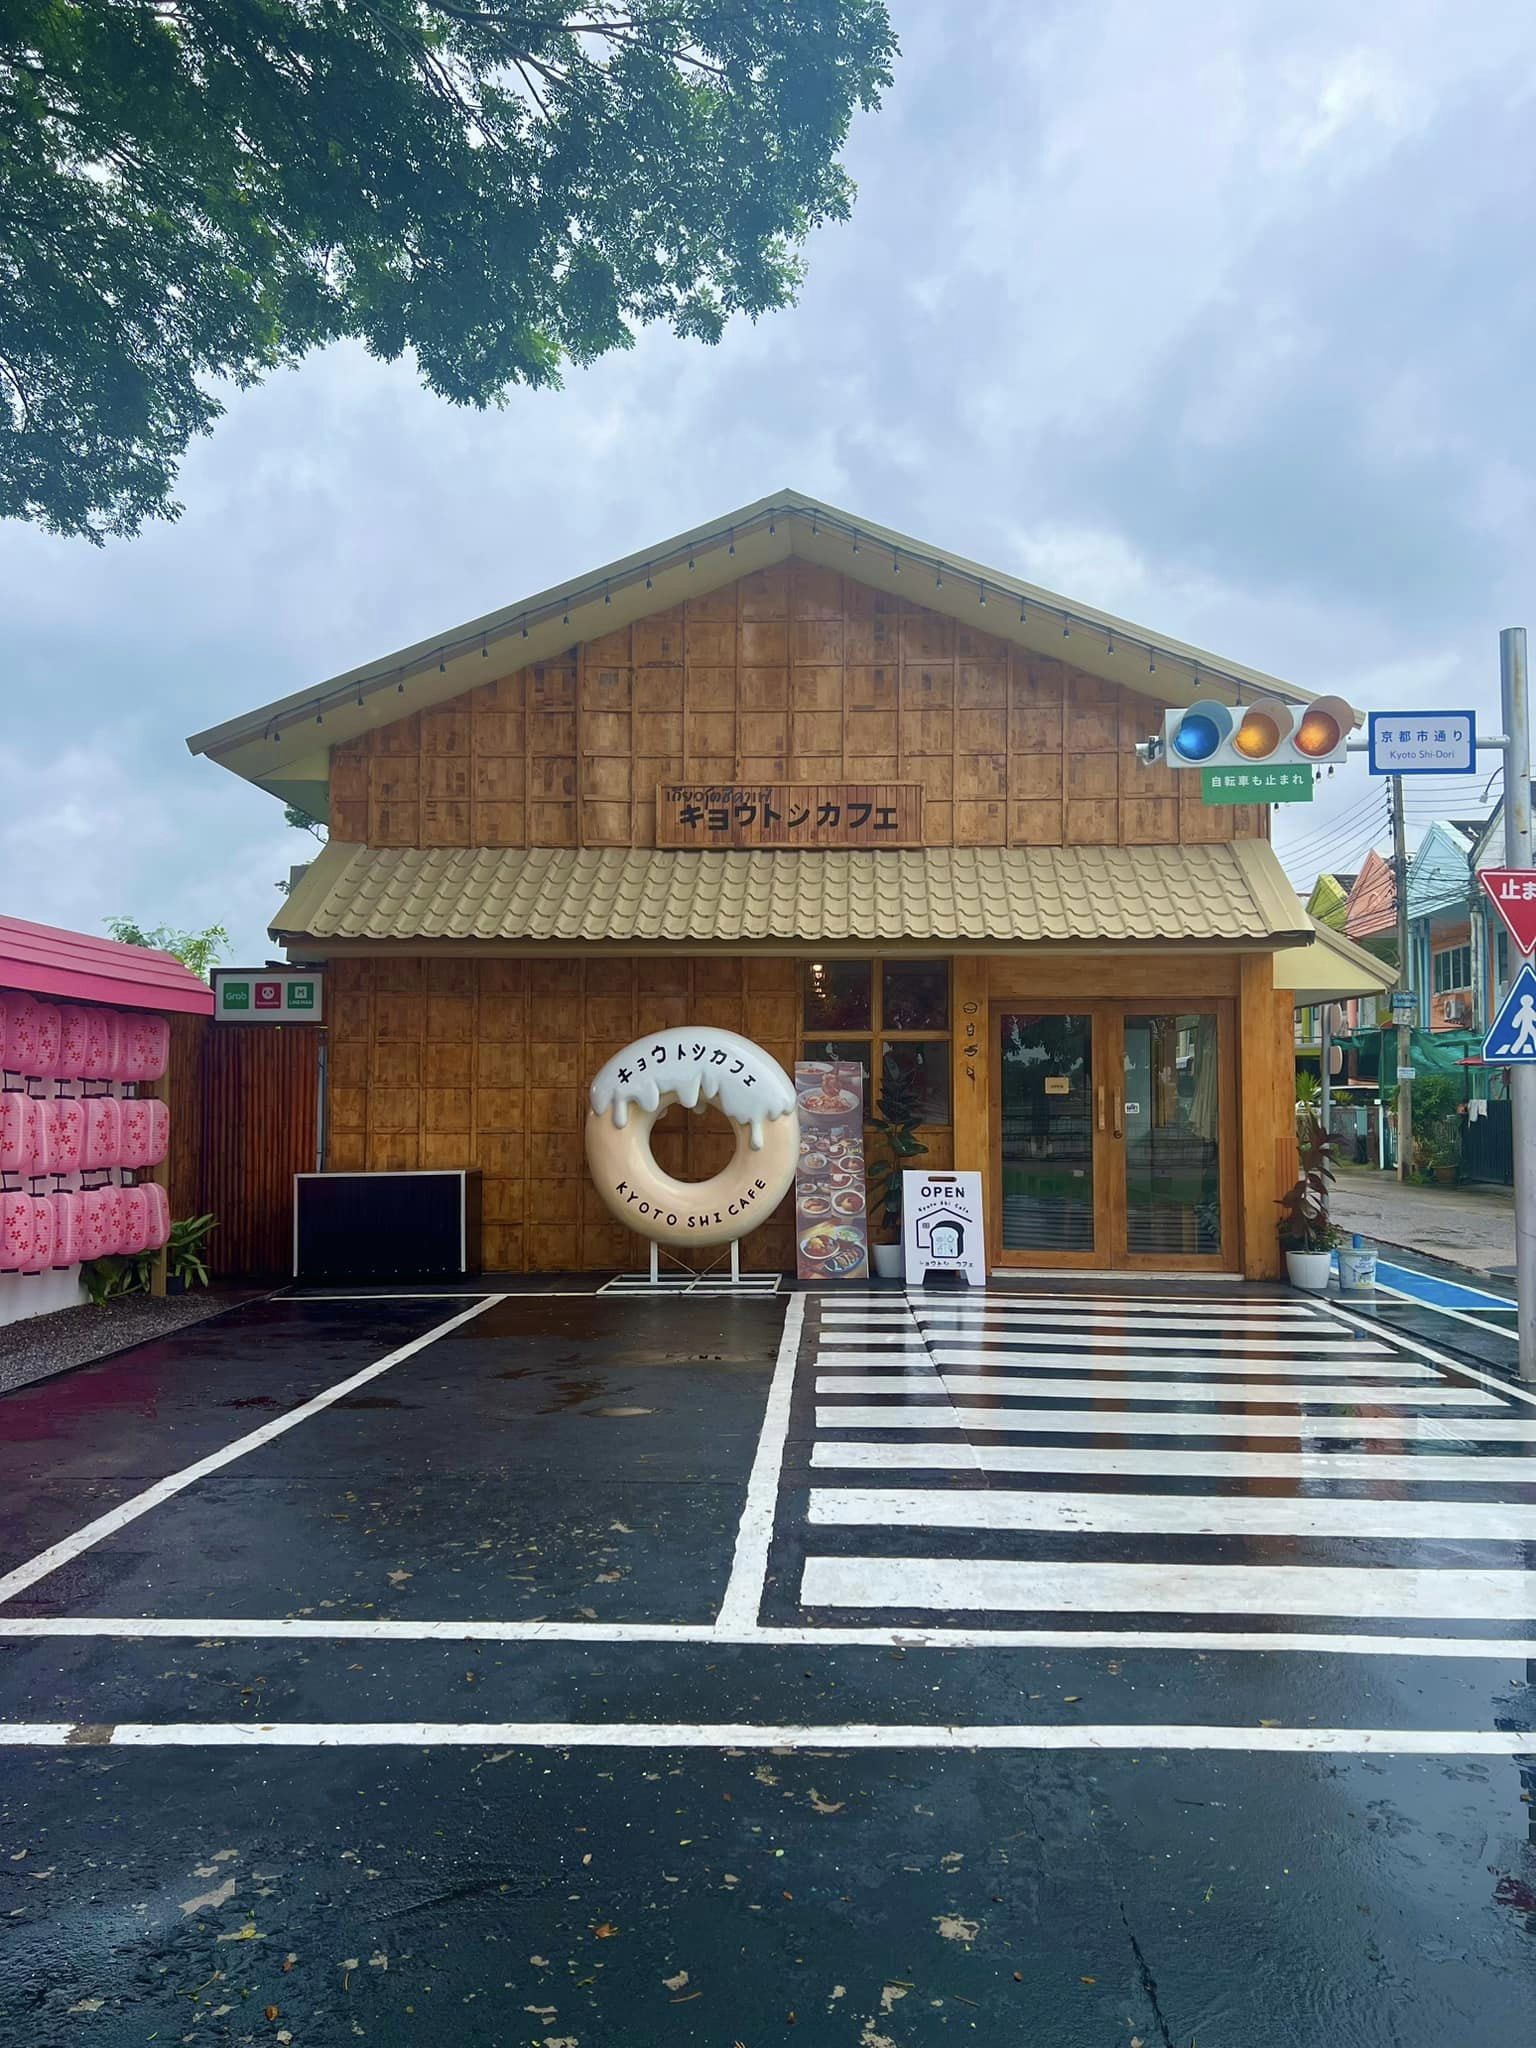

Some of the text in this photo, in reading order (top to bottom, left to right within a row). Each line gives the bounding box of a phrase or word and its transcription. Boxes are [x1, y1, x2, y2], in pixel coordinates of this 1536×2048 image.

[1381, 730, 1463, 743] 京都市通り
[1390, 750, 1455, 761] Kyoto Shi-Dori
[1211, 774, 1304, 787] 自転車も止まれ
[679, 802, 899, 831] キョウトシカフェ
[226, 991, 248, 1001] Grab
[617, 1043, 757, 1087] キョウトシカフェ
[921, 1186, 965, 1198] OPEN
[615, 1179, 767, 1228] KYOTO SHI CAFE
